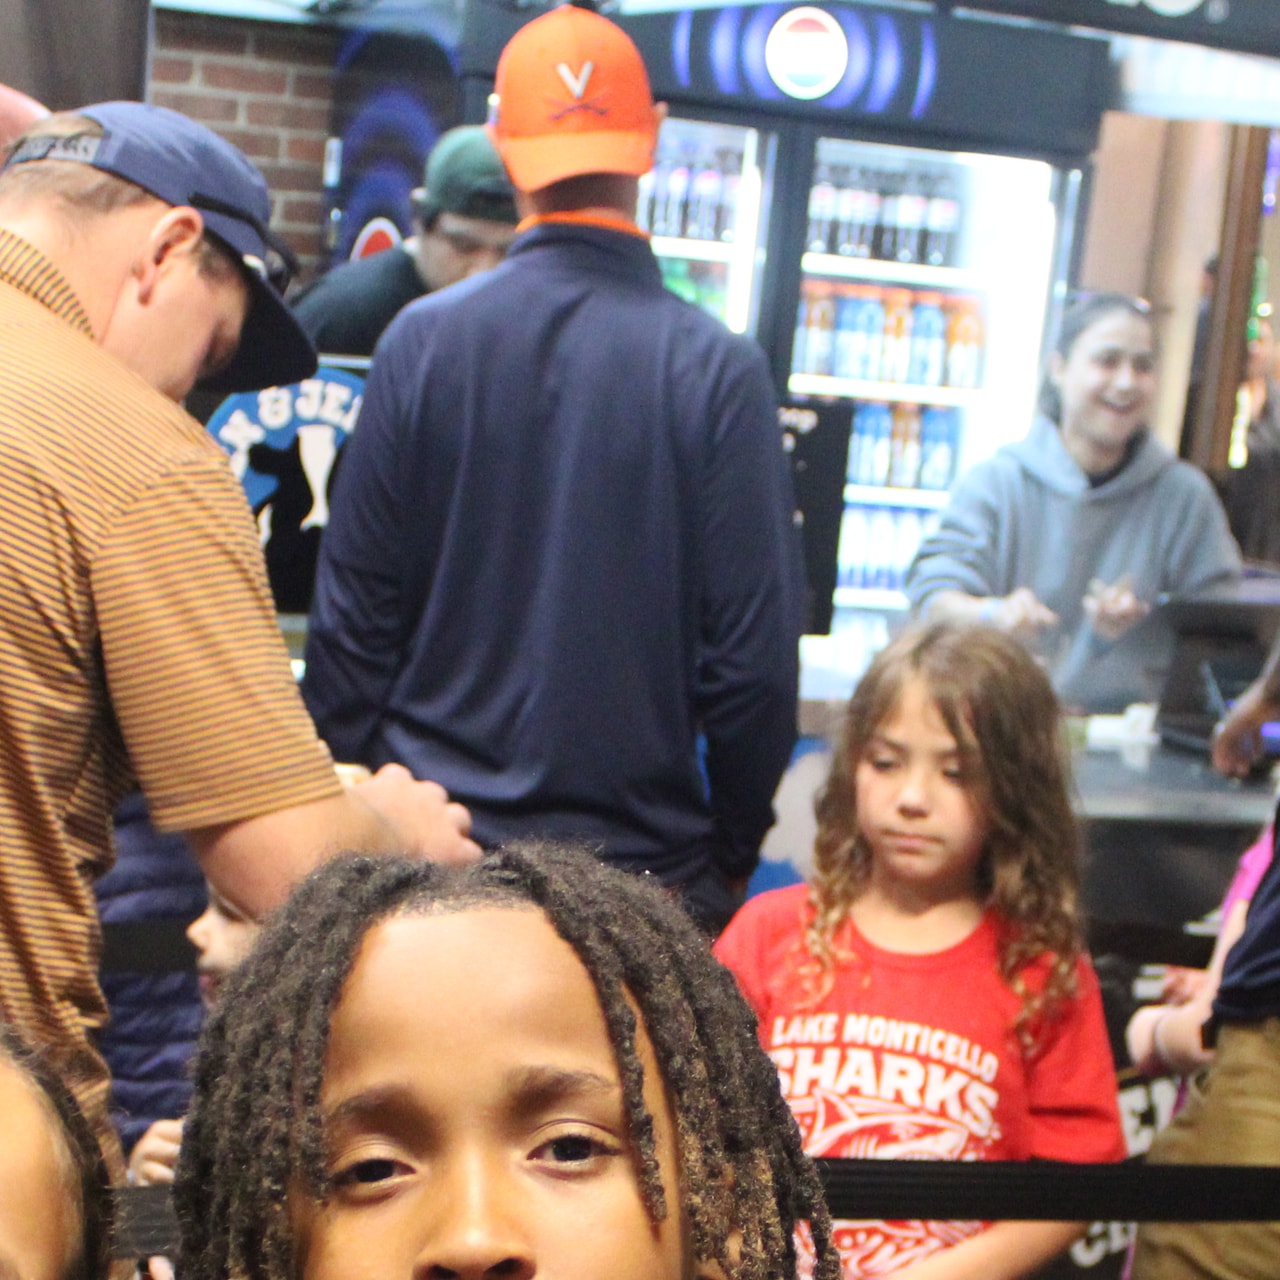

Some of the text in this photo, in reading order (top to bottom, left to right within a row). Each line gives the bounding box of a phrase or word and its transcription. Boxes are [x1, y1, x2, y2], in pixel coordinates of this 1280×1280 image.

[556, 61, 594, 99] V
[771, 1013, 999, 1083] LAKE MONTICELLO
[768, 1046, 1000, 1138] SHARKS
